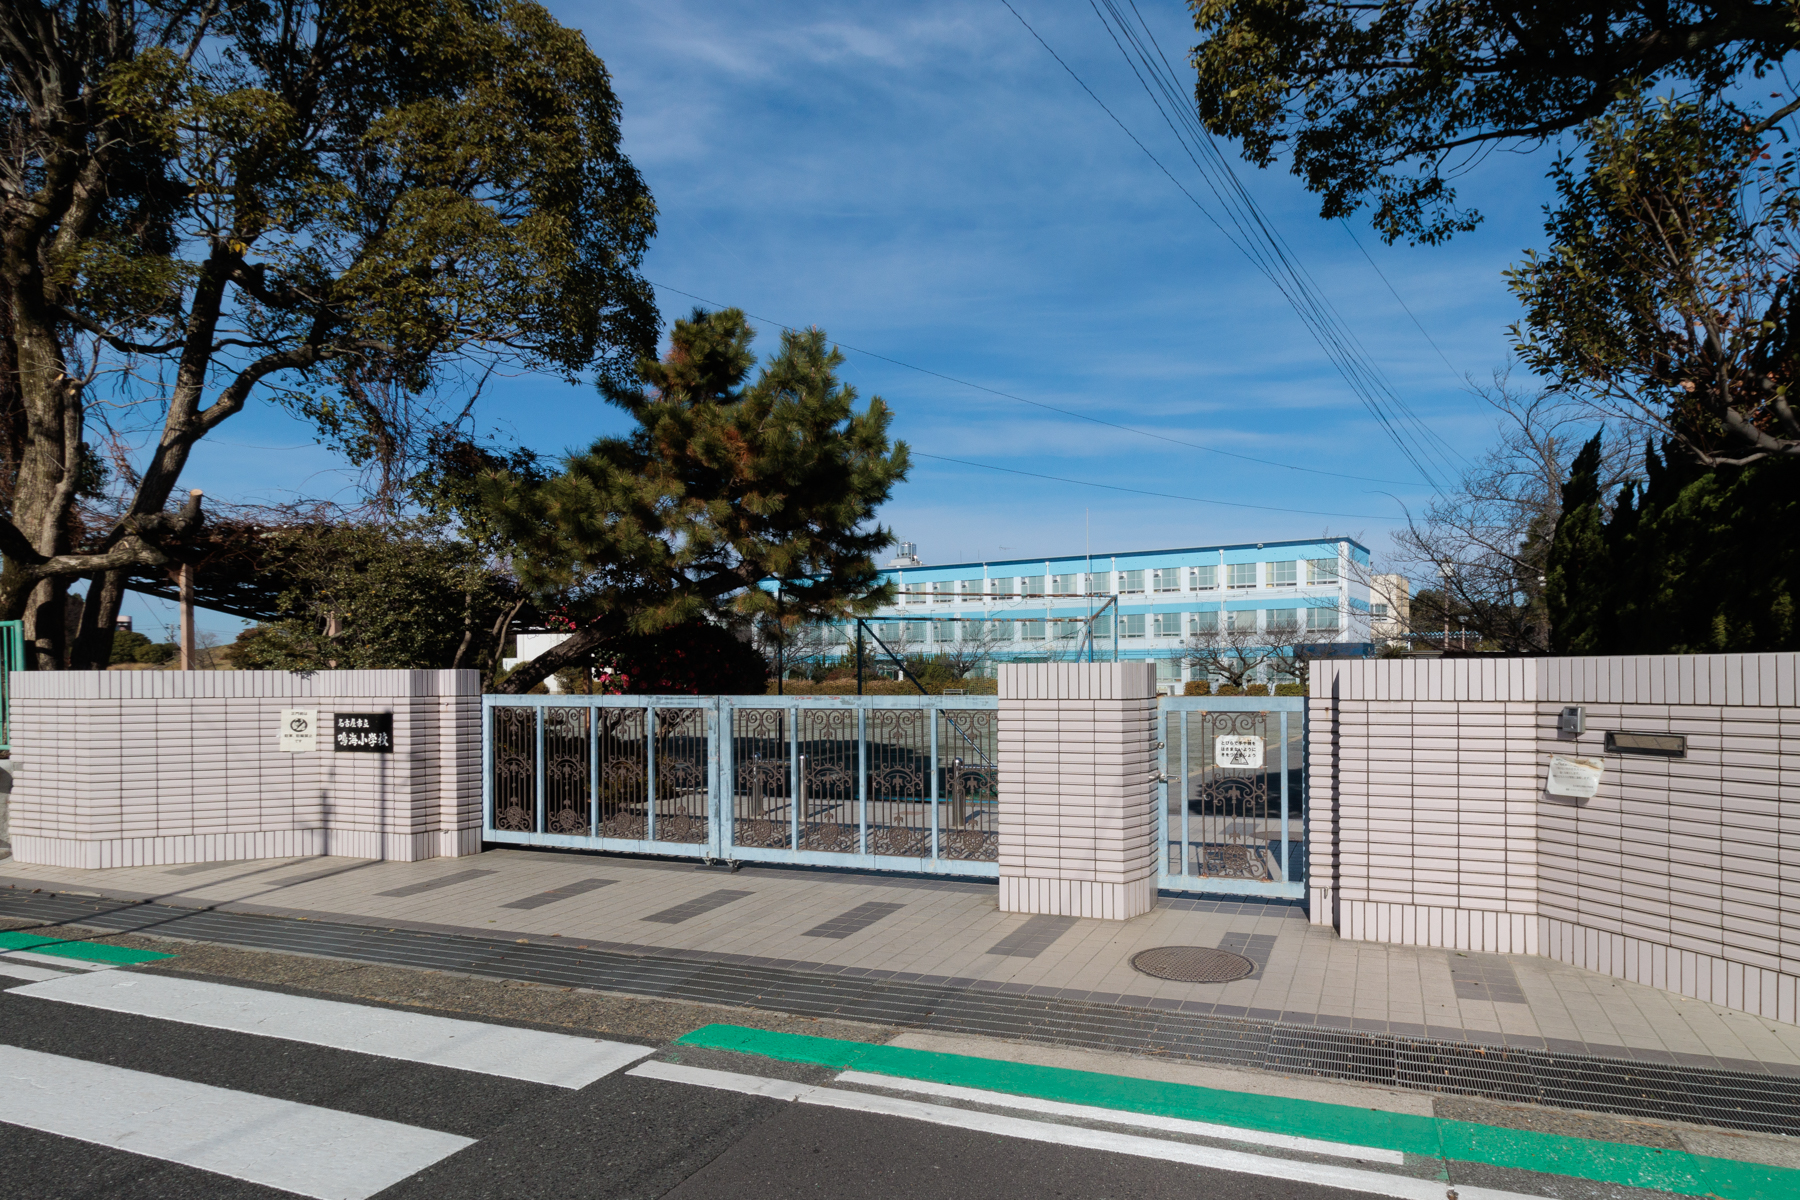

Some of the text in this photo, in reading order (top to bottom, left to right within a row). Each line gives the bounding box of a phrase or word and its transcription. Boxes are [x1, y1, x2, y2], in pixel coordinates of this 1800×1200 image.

[338, 718, 370, 728] 名古屋市立
[337, 731, 389, 747] 鳴海小学校
